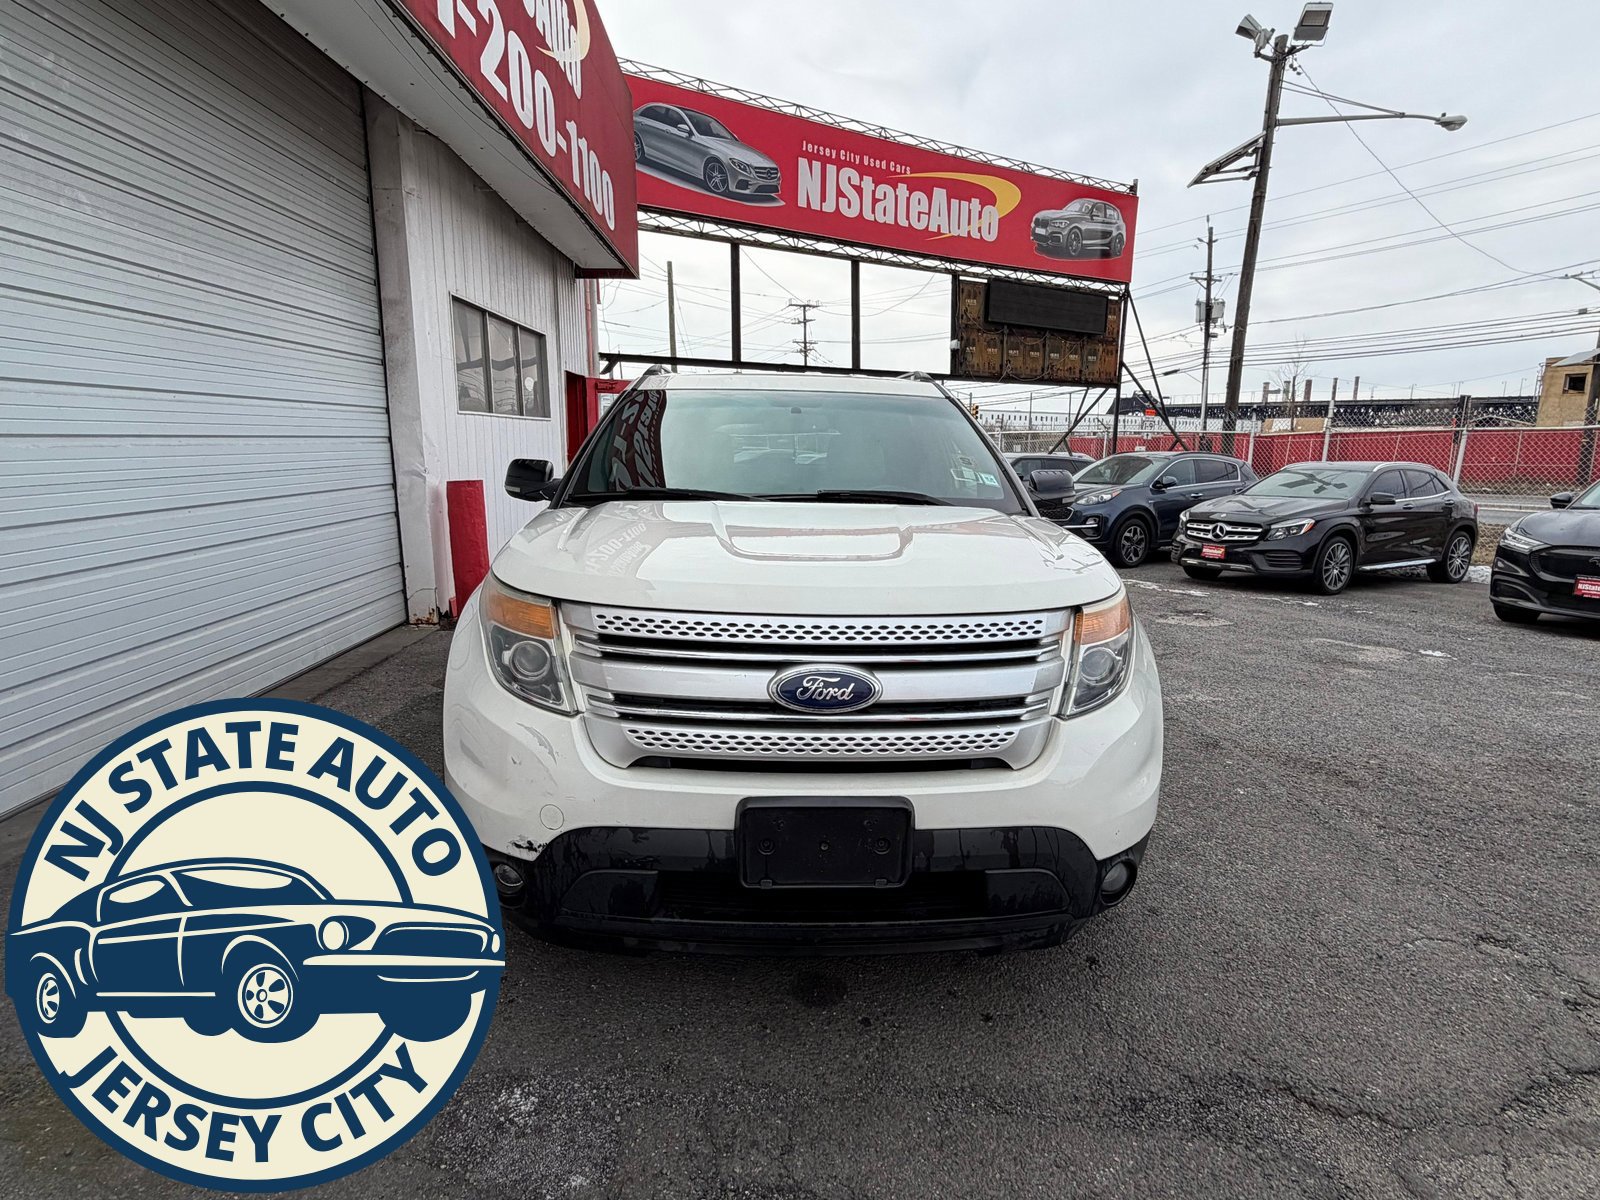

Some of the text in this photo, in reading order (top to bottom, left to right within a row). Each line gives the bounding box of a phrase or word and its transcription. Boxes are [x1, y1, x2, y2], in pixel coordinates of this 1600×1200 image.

[802, 140, 911, 175] Jersey City Used Cars
[797, 156, 999, 242] NJStateAuto
[796, 675, 855, 700] Ford
